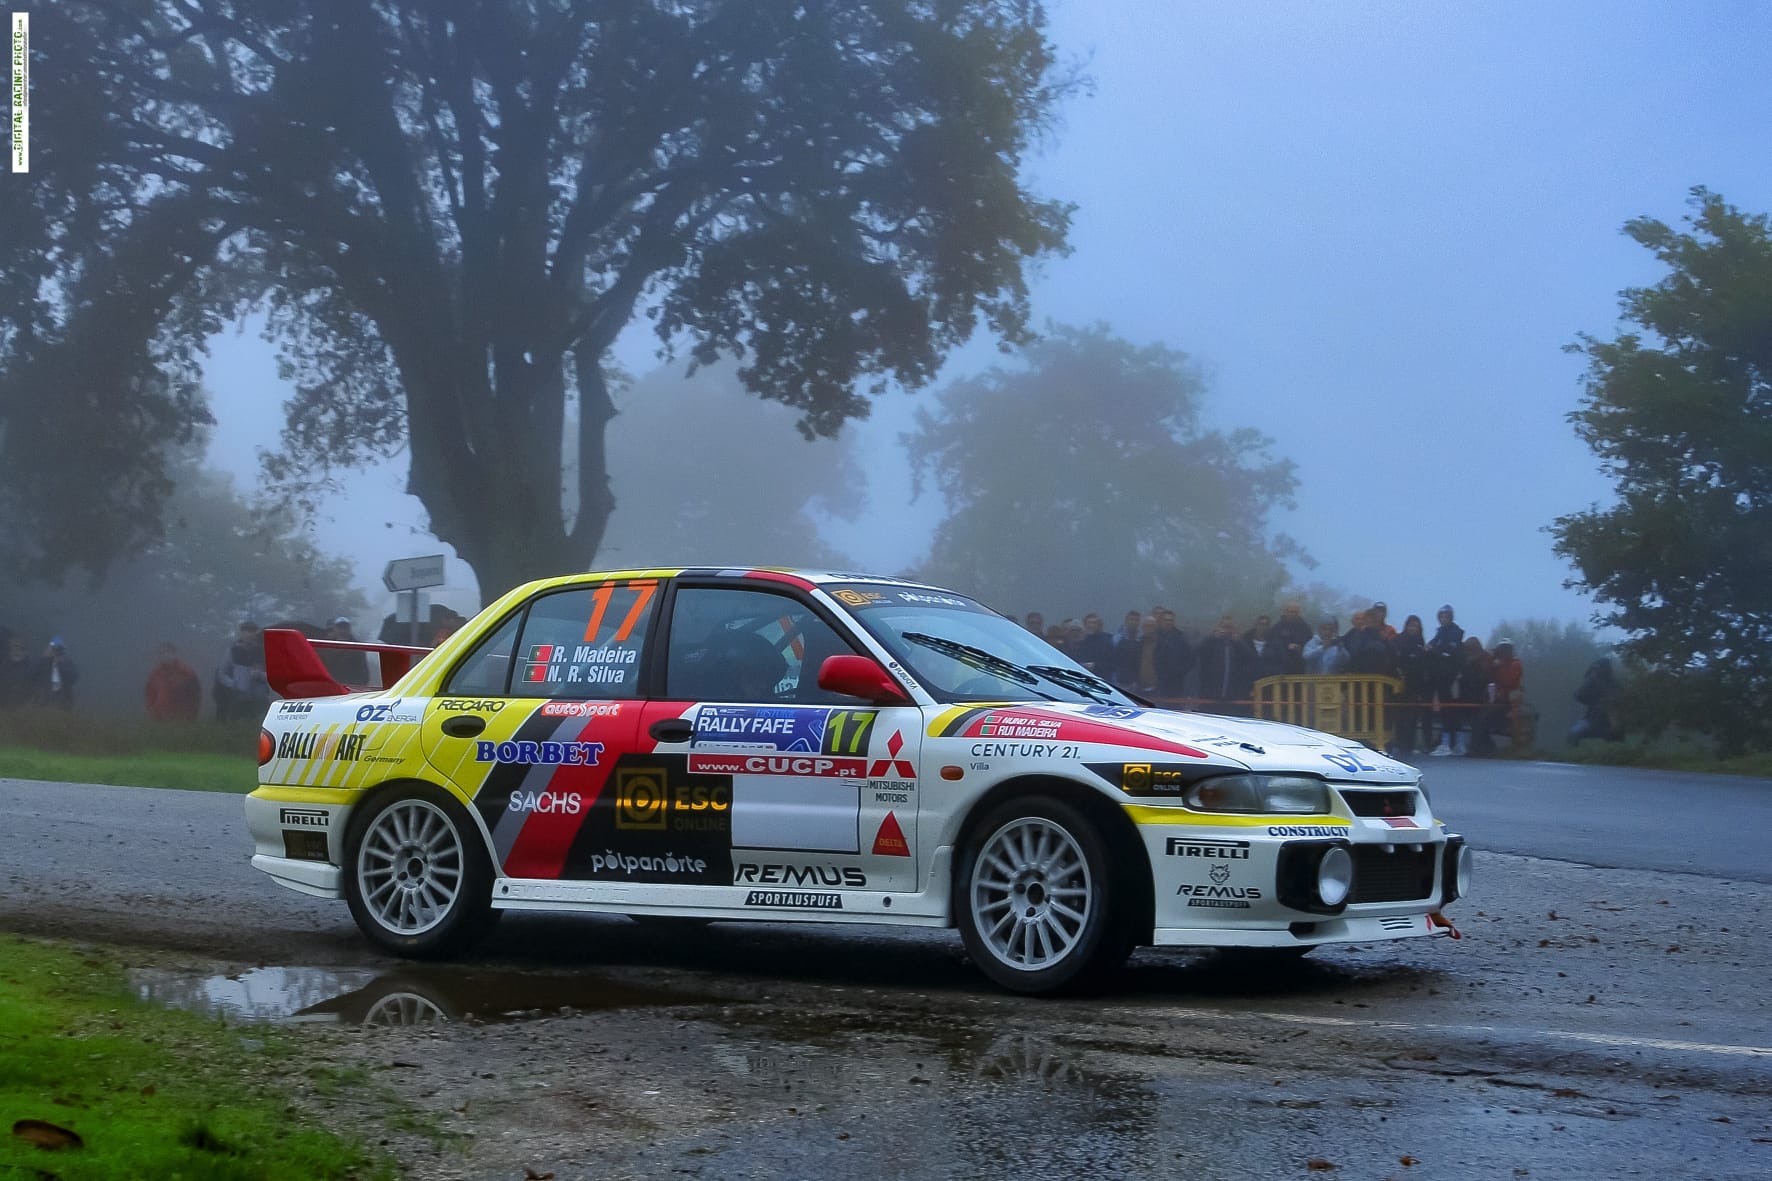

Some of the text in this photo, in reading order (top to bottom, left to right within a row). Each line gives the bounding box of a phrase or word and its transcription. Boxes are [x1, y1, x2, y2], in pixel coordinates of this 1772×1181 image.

[583, 579, 659, 642] 17
[552, 645, 636, 664] R. Madeira
[547, 664, 625, 683] N. R. Silva
[356, 704, 391, 722] OZ
[437, 700, 506, 713] RECARO
[697, 717, 796, 734] RALLY FAFE
[828, 710, 875, 753] 17
[998, 725, 1058, 738] RUI MADEIRA
[1038, 720, 1062, 728] SILVA
[277, 732, 367, 761] RALLI ART
[475, 741, 604, 766] BORBET
[971, 743, 1059, 758] CENTURY
[363, 755, 405, 764] Germany
[696, 756, 857, 777] www.CUCP.pt
[970, 762, 990, 771] Villa
[869, 780, 915, 791] MITSUBISHI
[508, 790, 582, 814] SACHS
[674, 786, 728, 811] ESC
[875, 793, 908, 802] MOTORS
[280, 808, 329, 826] PIRELLI
[674, 817, 727, 831] ONLINE
[1166, 837, 1250, 859] PIRELLI
[734, 863, 867, 887] REMUS
[751, 892, 838, 907] SPORTAUSPUFF
[1176, 884, 1262, 899] REMUS
